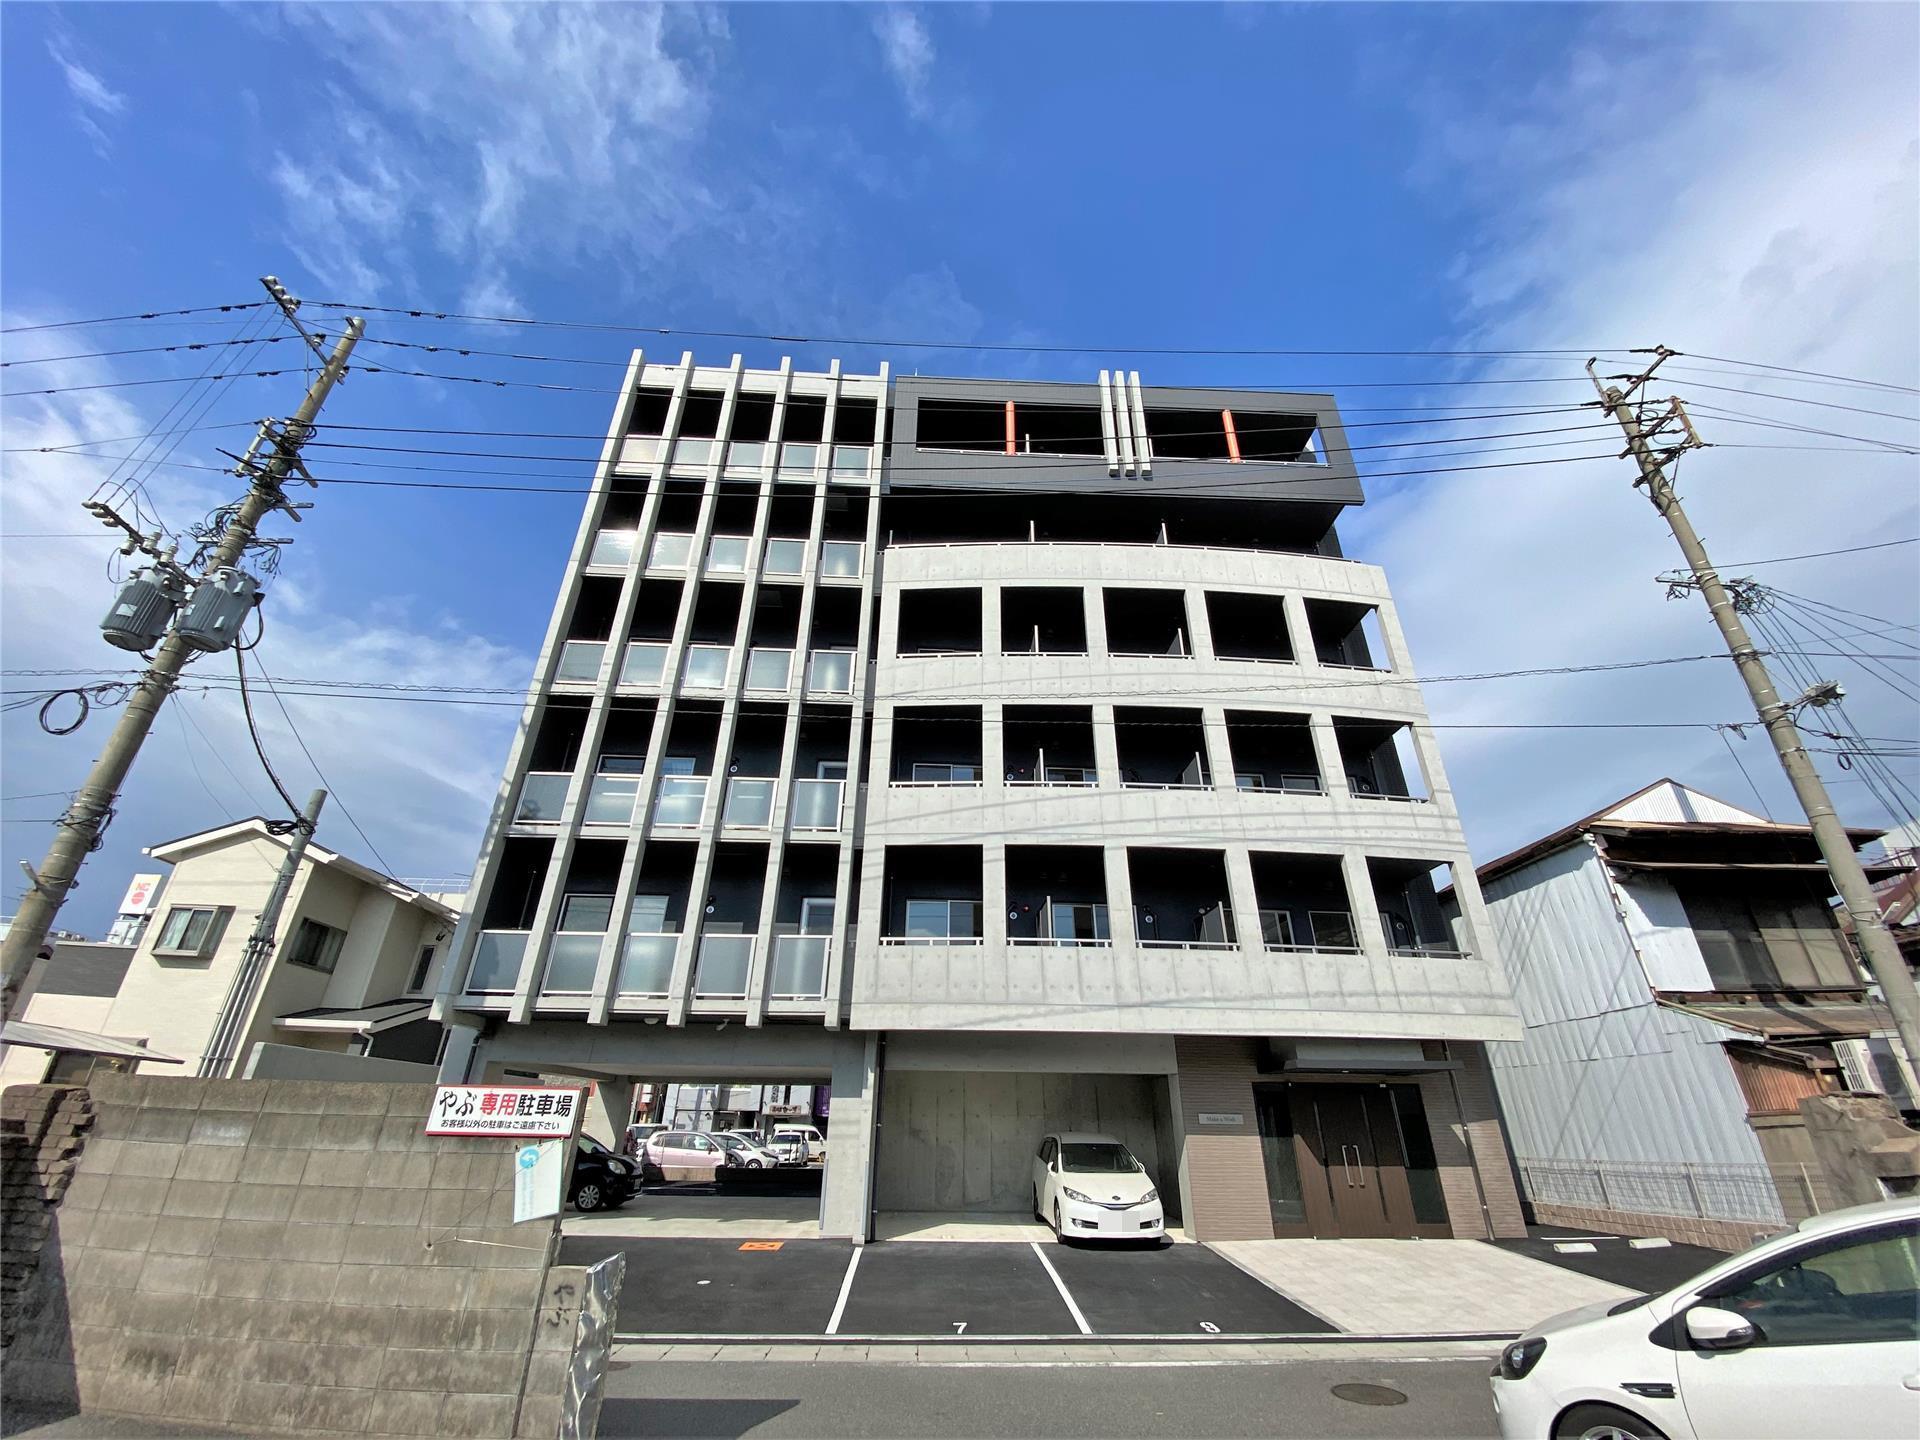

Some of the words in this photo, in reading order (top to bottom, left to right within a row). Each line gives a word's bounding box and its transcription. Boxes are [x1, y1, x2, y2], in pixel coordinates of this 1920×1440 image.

[440, 1090, 477, 1117] やぶ
[480, 1092, 573, 1117] 専用駐車場
[441, 1119, 560, 1130] お客様以外の駐車はご遠慮下さい
[952, 1322, 968, 1334] 7
